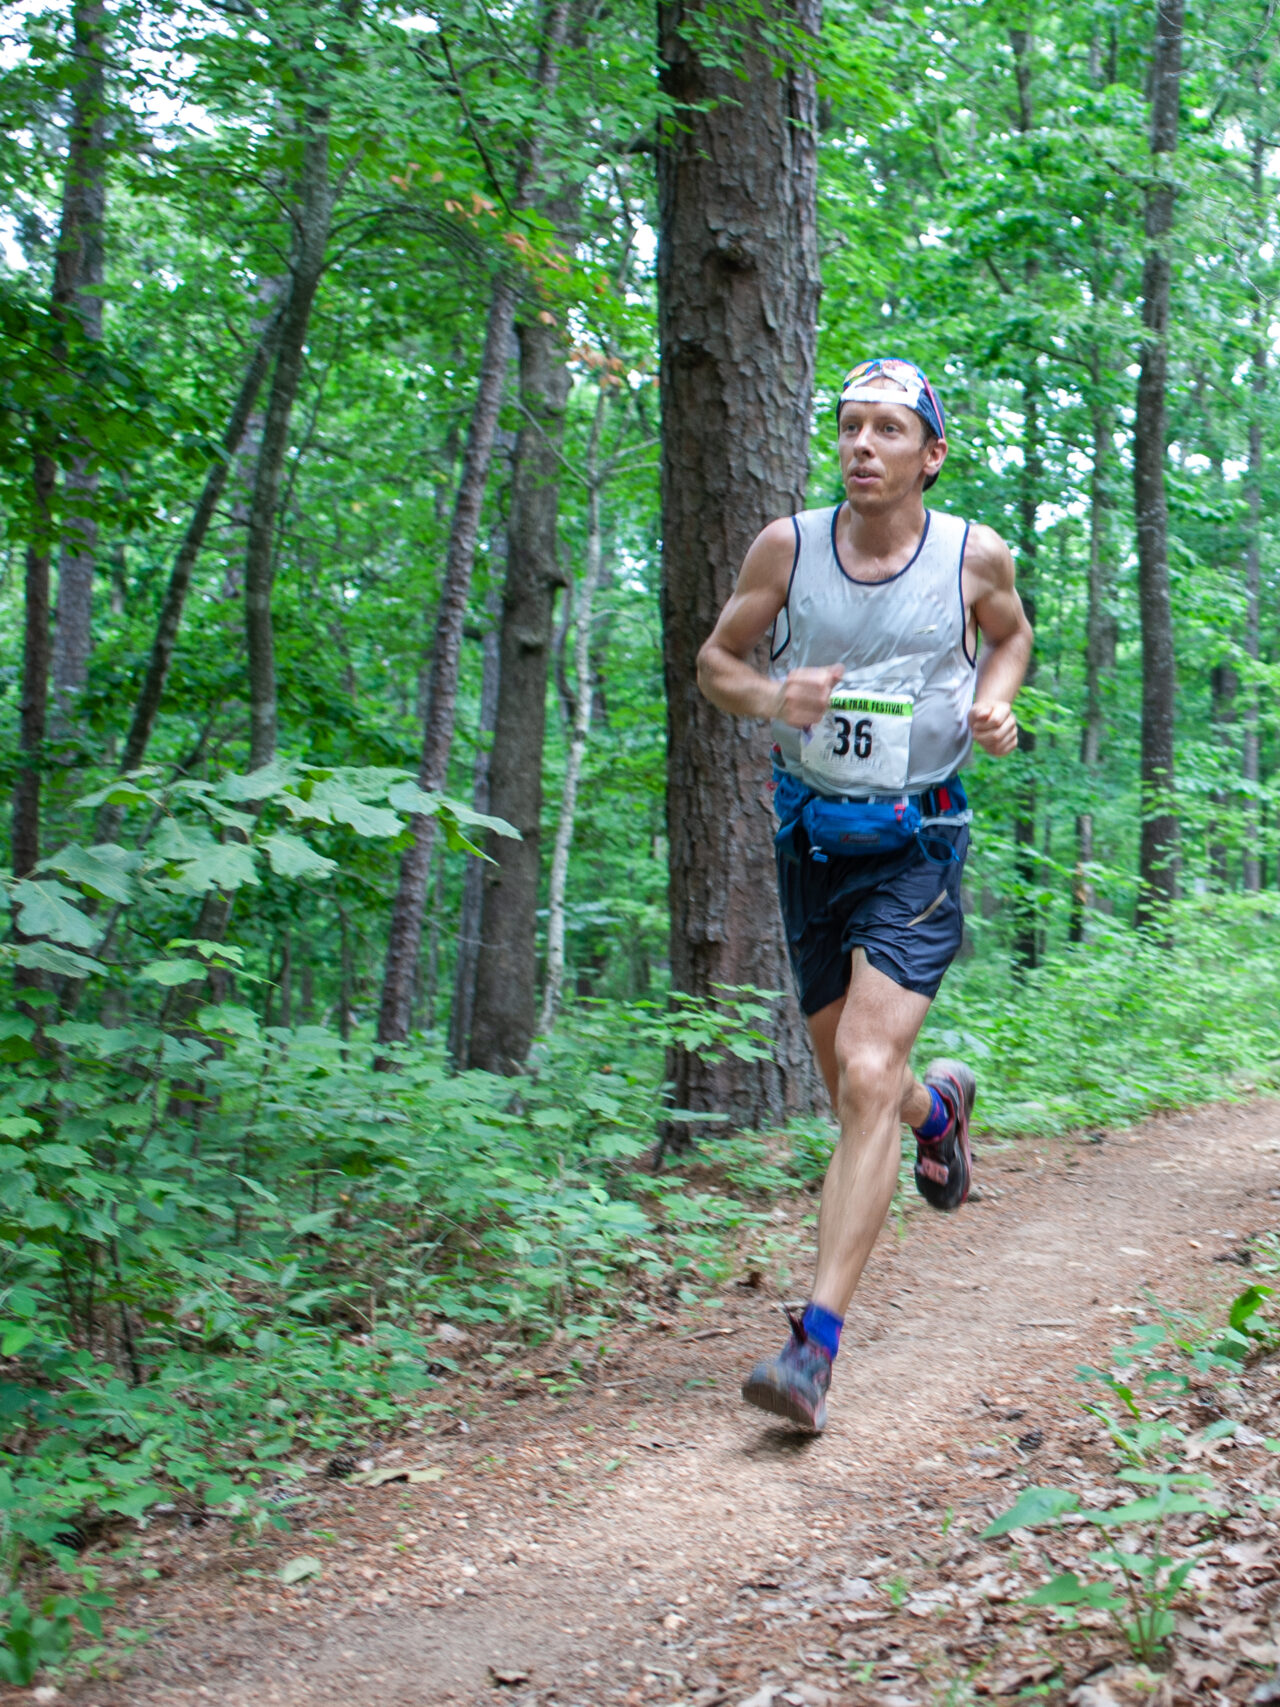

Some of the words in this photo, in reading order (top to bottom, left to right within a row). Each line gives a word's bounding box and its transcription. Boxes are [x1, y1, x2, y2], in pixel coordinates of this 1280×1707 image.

[849, 698, 870, 712] TRAIL
[871, 700, 904, 716] FESTIVAL
[833, 716, 873, 759] 36
